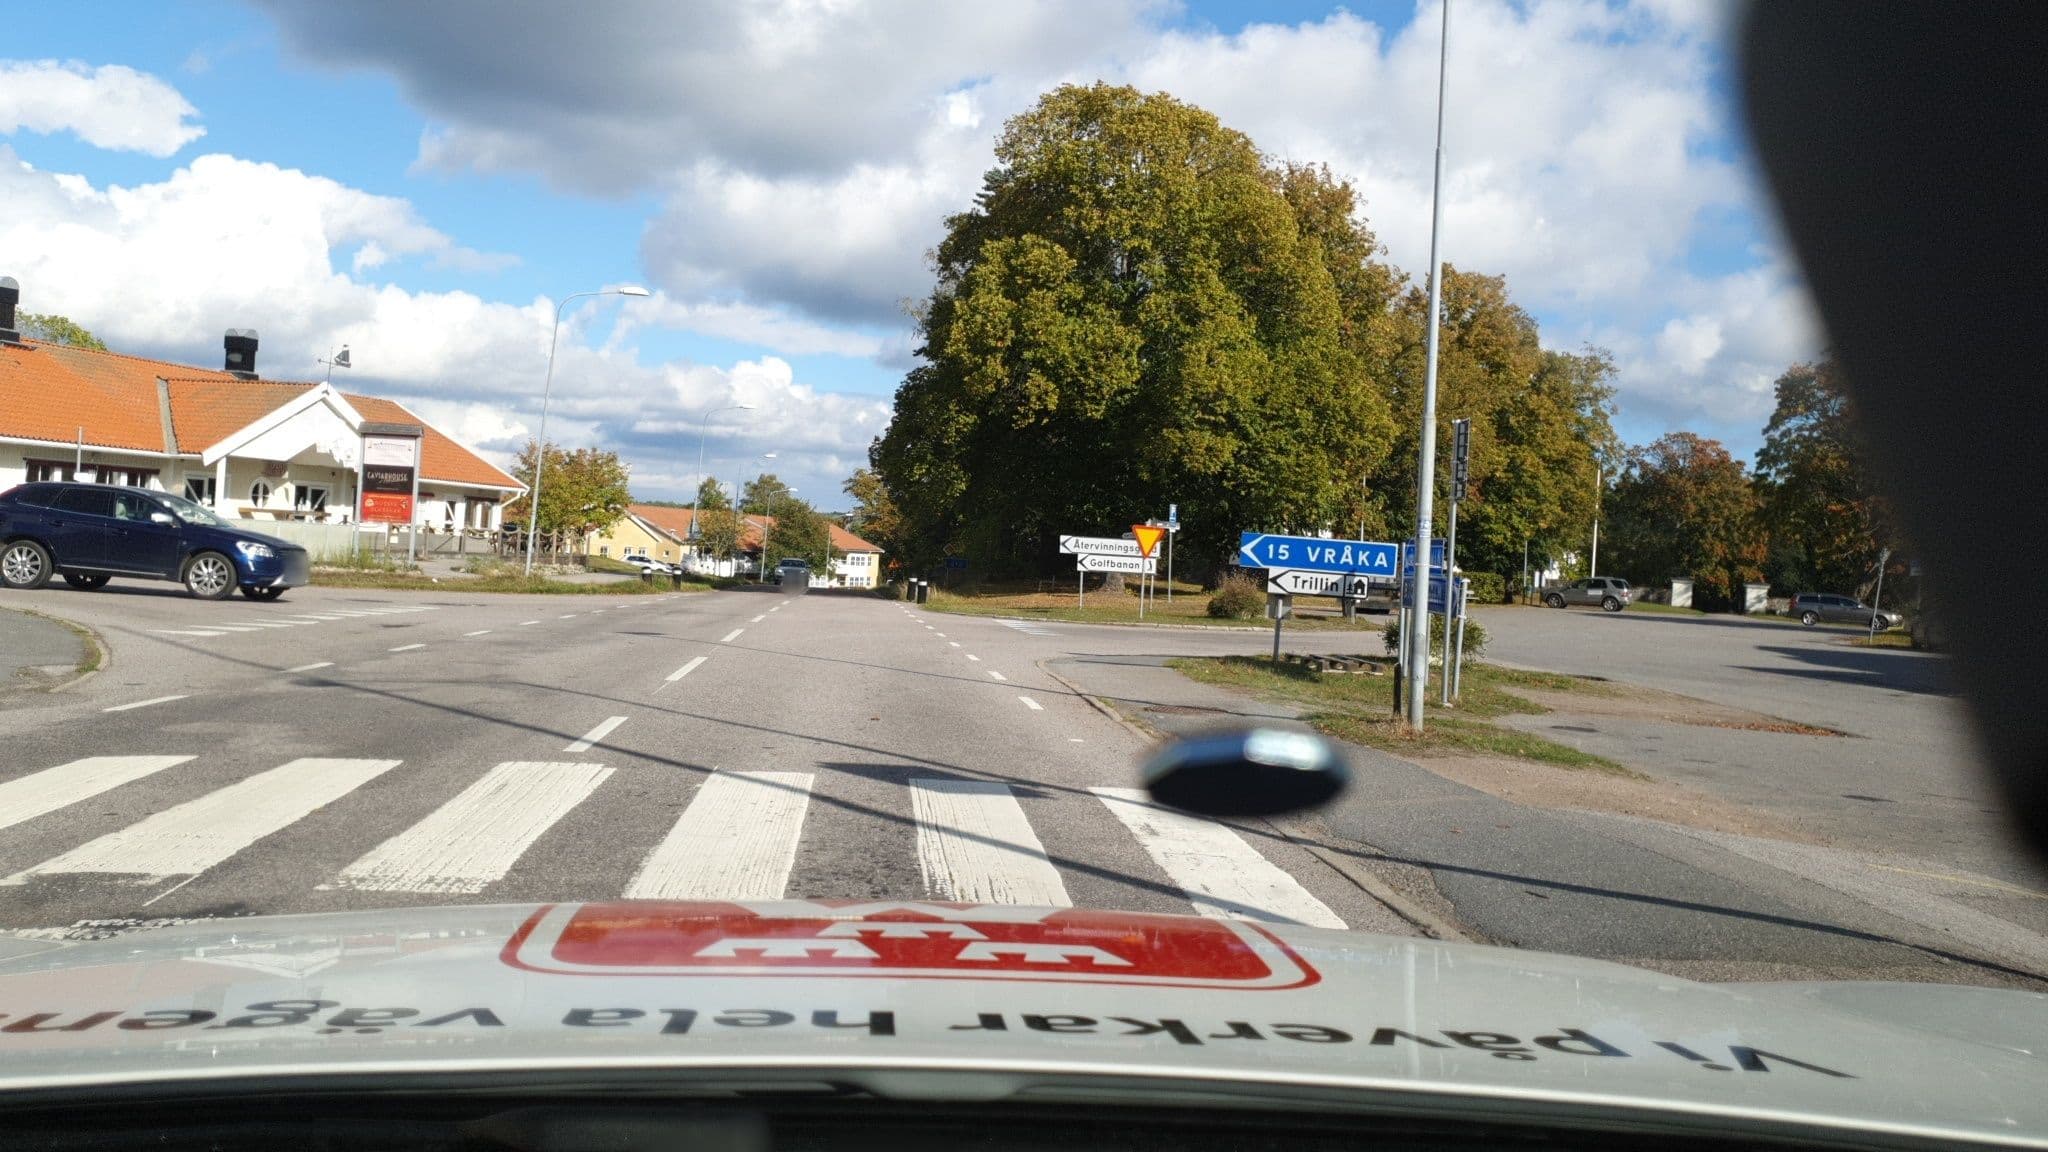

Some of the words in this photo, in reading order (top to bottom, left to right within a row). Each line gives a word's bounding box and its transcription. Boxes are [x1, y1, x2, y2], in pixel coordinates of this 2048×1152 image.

[1090, 558, 1140, 573] Golfbanan
[1268, 543, 1290, 560] 15
[1306, 544, 1389, 567] VRÅKA
[1292, 575, 1340, 592] Trillin
[560, 1006, 896, 1036] hela
[948, 1012, 1632, 1061] påverkar
[1651, 1039, 1862, 1080] Vi
